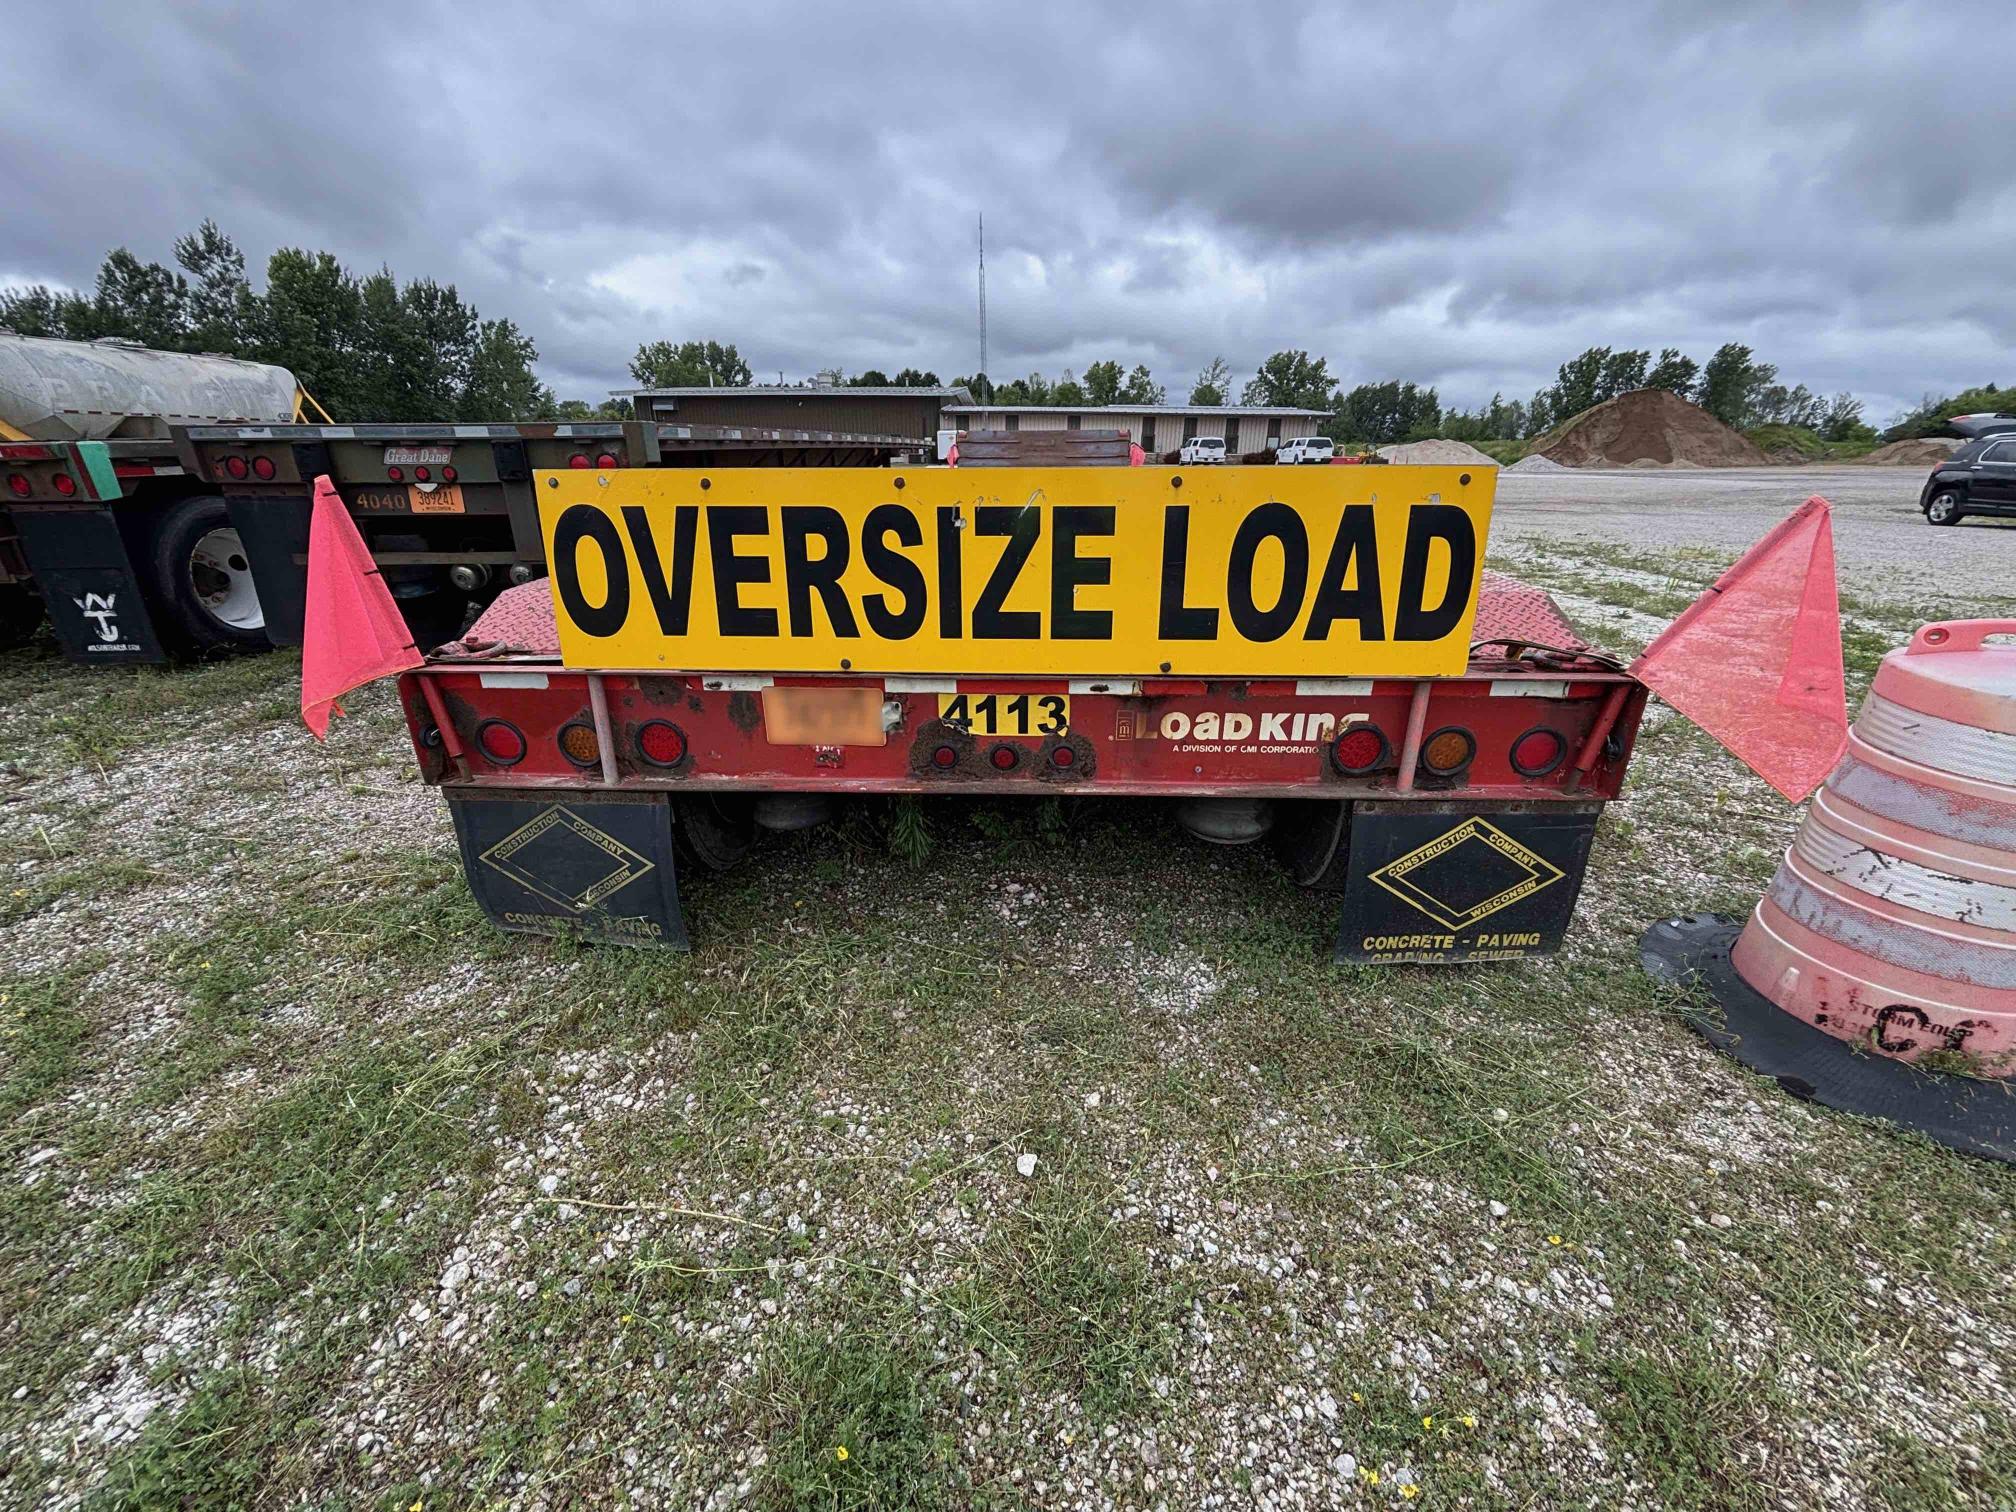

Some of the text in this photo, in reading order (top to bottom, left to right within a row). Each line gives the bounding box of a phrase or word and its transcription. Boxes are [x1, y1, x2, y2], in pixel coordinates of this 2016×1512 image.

[386, 449, 448, 463] Great Dane
[357, 493, 406, 509] 4040
[417, 491, 455, 506] 389241
[553, 502, 1476, 643] OVERSIZE LOAD
[941, 694, 1068, 735] 4113
[1182, 744, 1221, 753] DIVISION
[1225, 745, 1237, 753] OF
[494, 811, 560, 859] CONSTRUCTION
[573, 821, 624, 856] COMPANY
[1388, 823, 1476, 877] CONSTRUCTION
[1489, 833, 1537, 868] COMPANY
[1470, 880, 1537, 918] WISCONSIN
[1363, 935, 1455, 951] CONCRETE
[1476, 933, 1541, 948] PAVING
